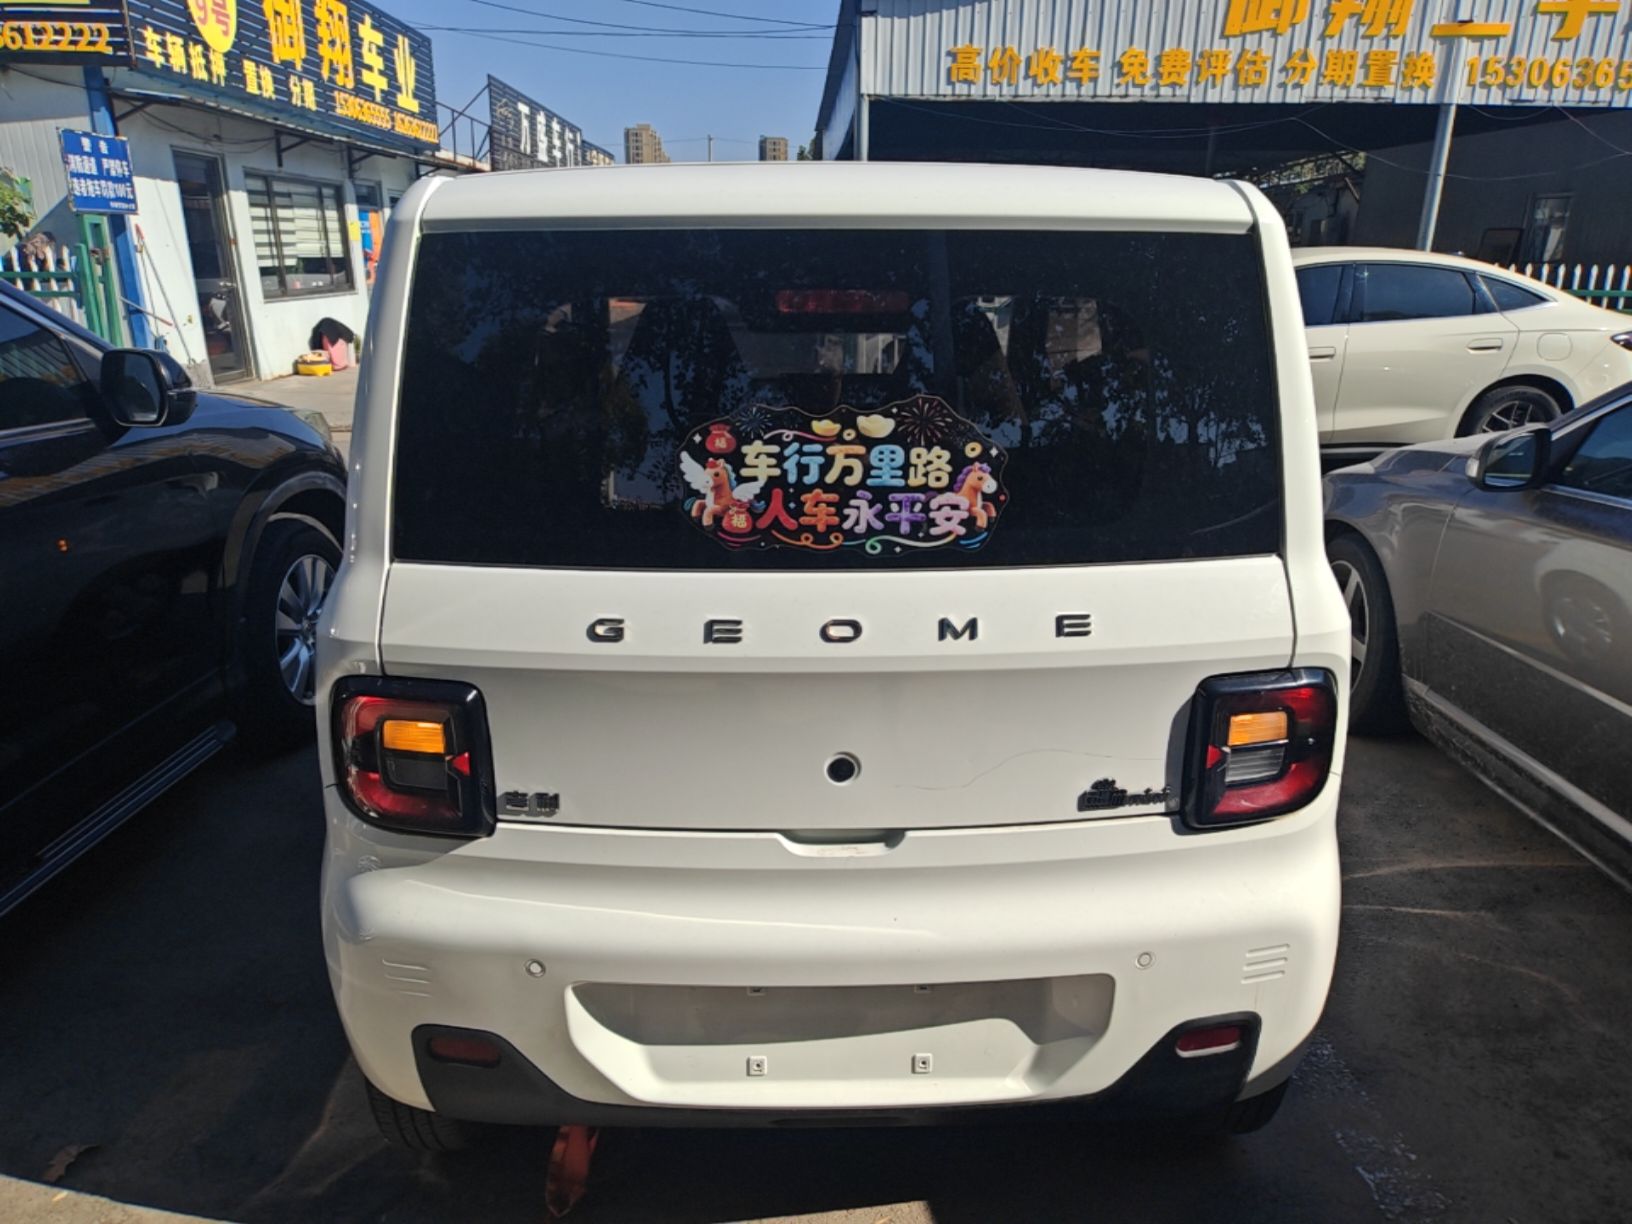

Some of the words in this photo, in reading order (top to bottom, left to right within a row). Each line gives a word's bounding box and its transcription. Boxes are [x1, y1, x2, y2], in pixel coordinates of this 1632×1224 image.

[0, 20, 113, 55] 612222
[948, 44, 1101, 86] 高价收车
[1119, 46, 1271, 88] 免费评估
[1284, 48, 1437, 90] 分期置换
[1466, 55, 1632, 90] 15306365
[739, 440, 953, 488] 车行万里路
[731, 514, 748, 529] 福
[755, 488, 970, 536] 人车永平安
[586, 613, 1093, 645] GEOME
